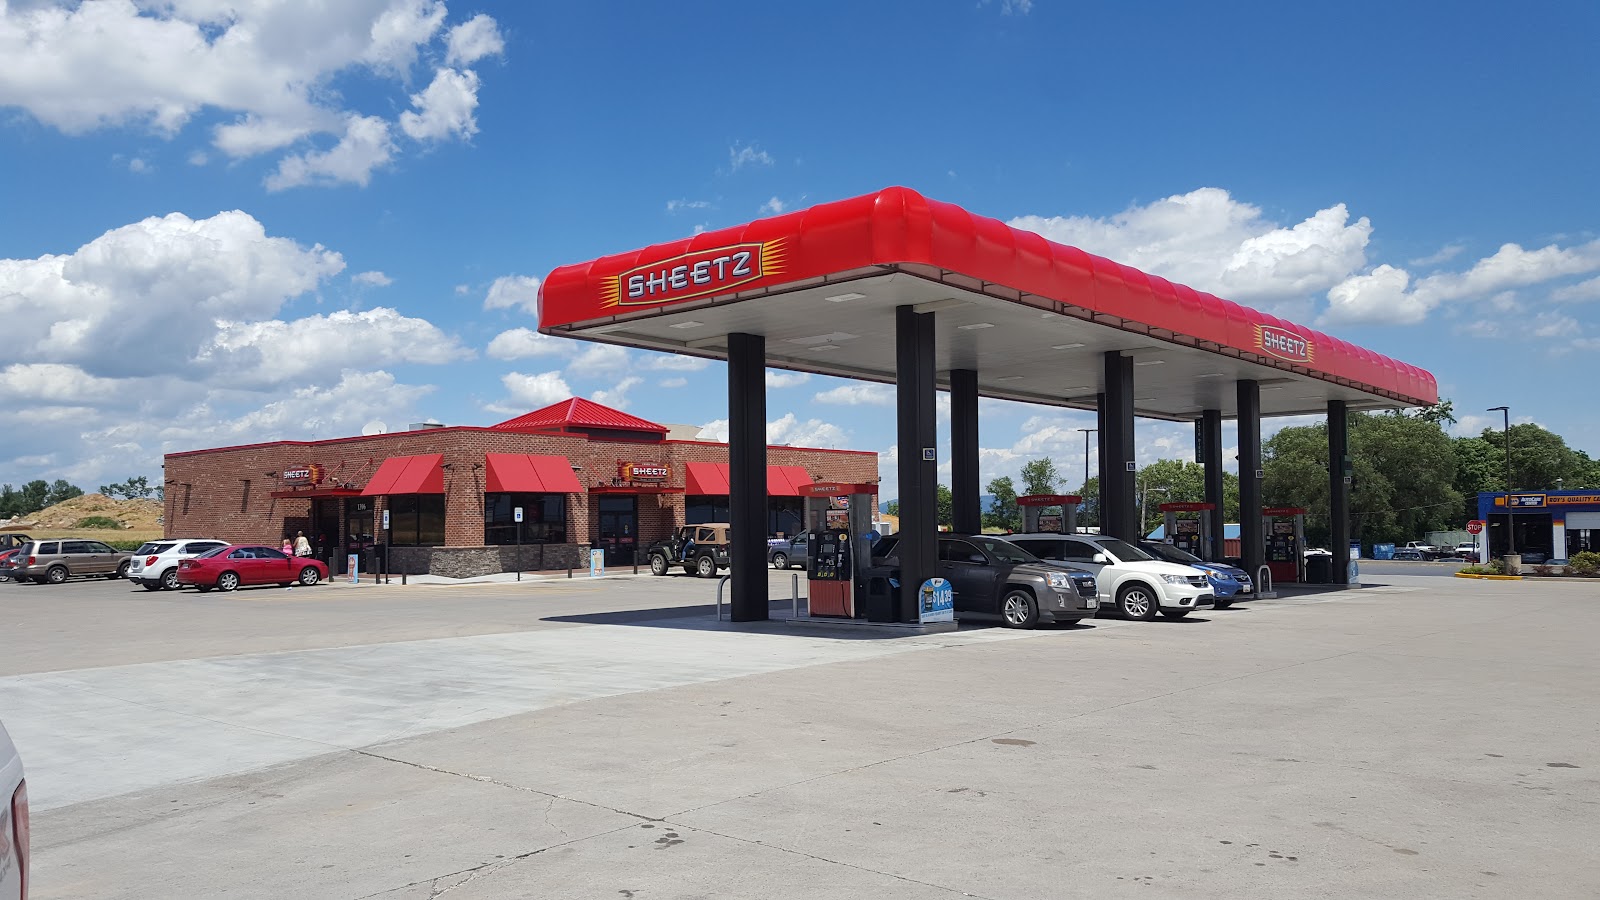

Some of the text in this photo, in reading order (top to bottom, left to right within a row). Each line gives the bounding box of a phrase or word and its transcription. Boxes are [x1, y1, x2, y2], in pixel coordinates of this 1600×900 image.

[627, 250, 752, 299] SHEETZ
[1264, 330, 1306, 357] SHEETZ
[283, 469, 310, 479] SHEETZ
[633, 467, 667, 476] SHEETZ
